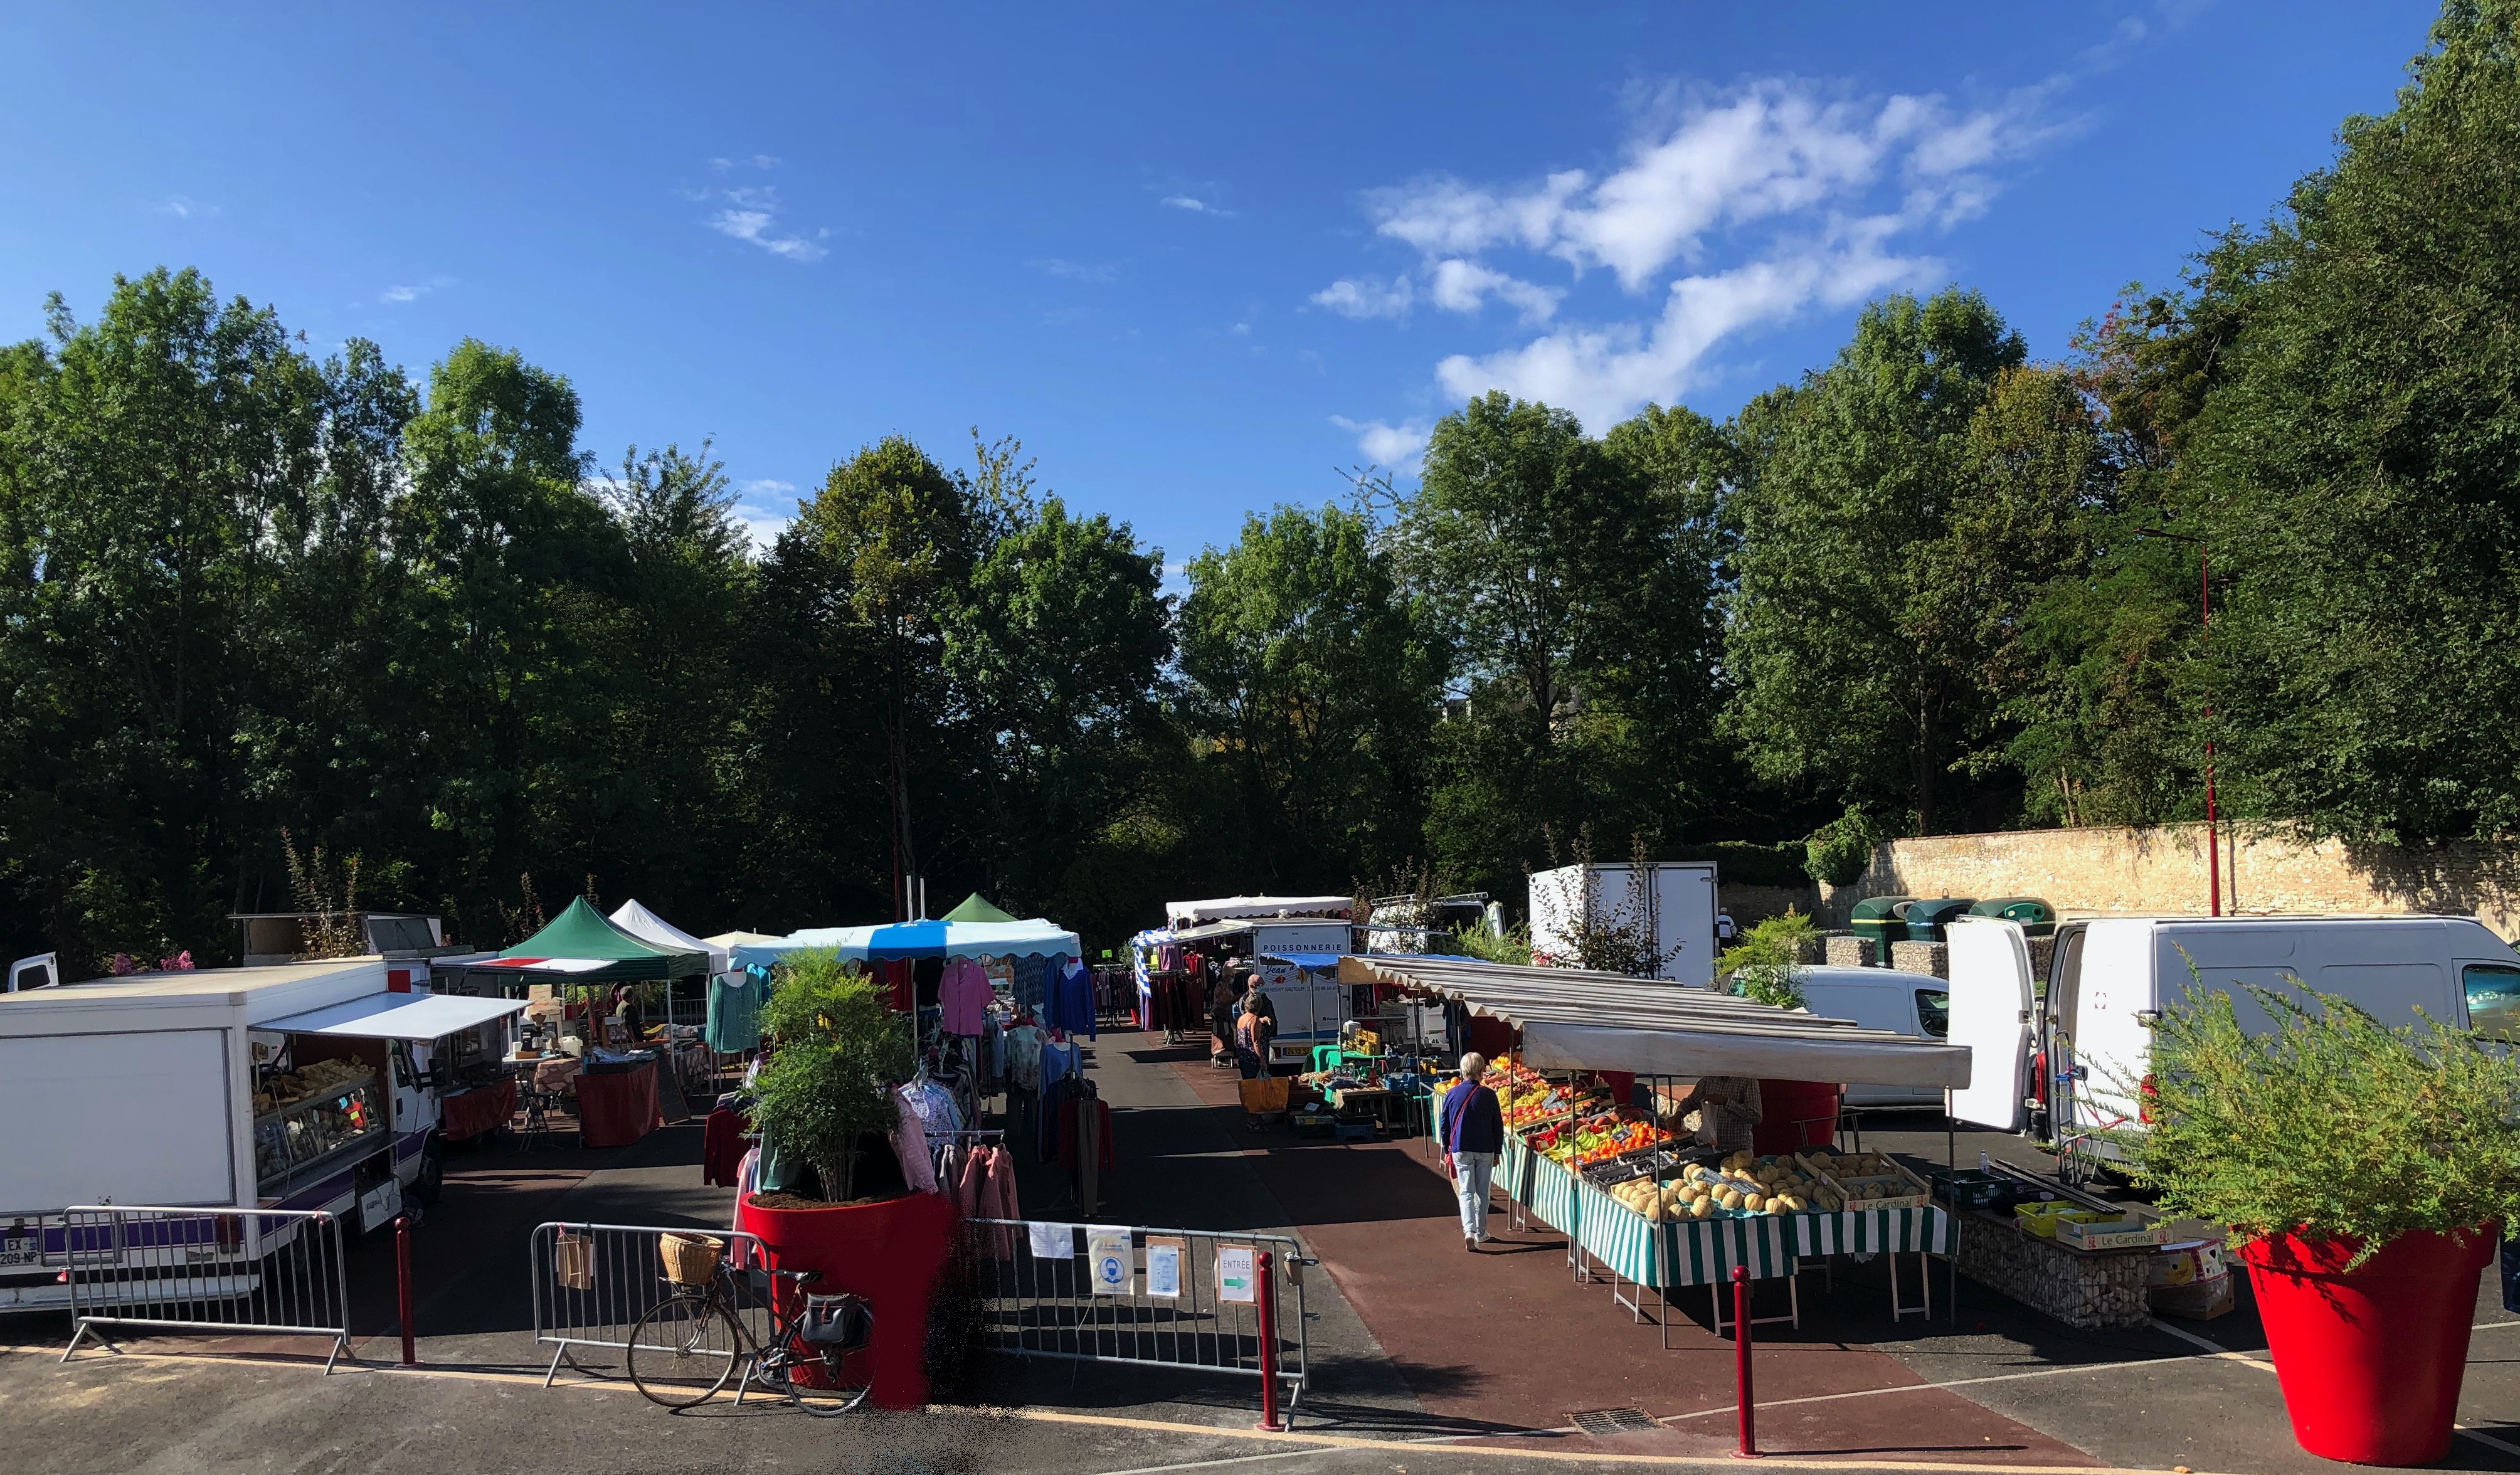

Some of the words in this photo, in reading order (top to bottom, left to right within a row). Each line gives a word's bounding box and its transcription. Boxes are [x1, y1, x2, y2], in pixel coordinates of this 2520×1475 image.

[1862, 1202, 1873, 1210] Le
[1875, 1198, 1912, 1209] Cardinal
[2102, 1236, 2113, 1246] Le
[2115, 1233, 2154, 1244] Cardinal
[0, 1251, 38, 1265] 209-NP
[1223, 1258, 1250, 1269] ENTRÉE
